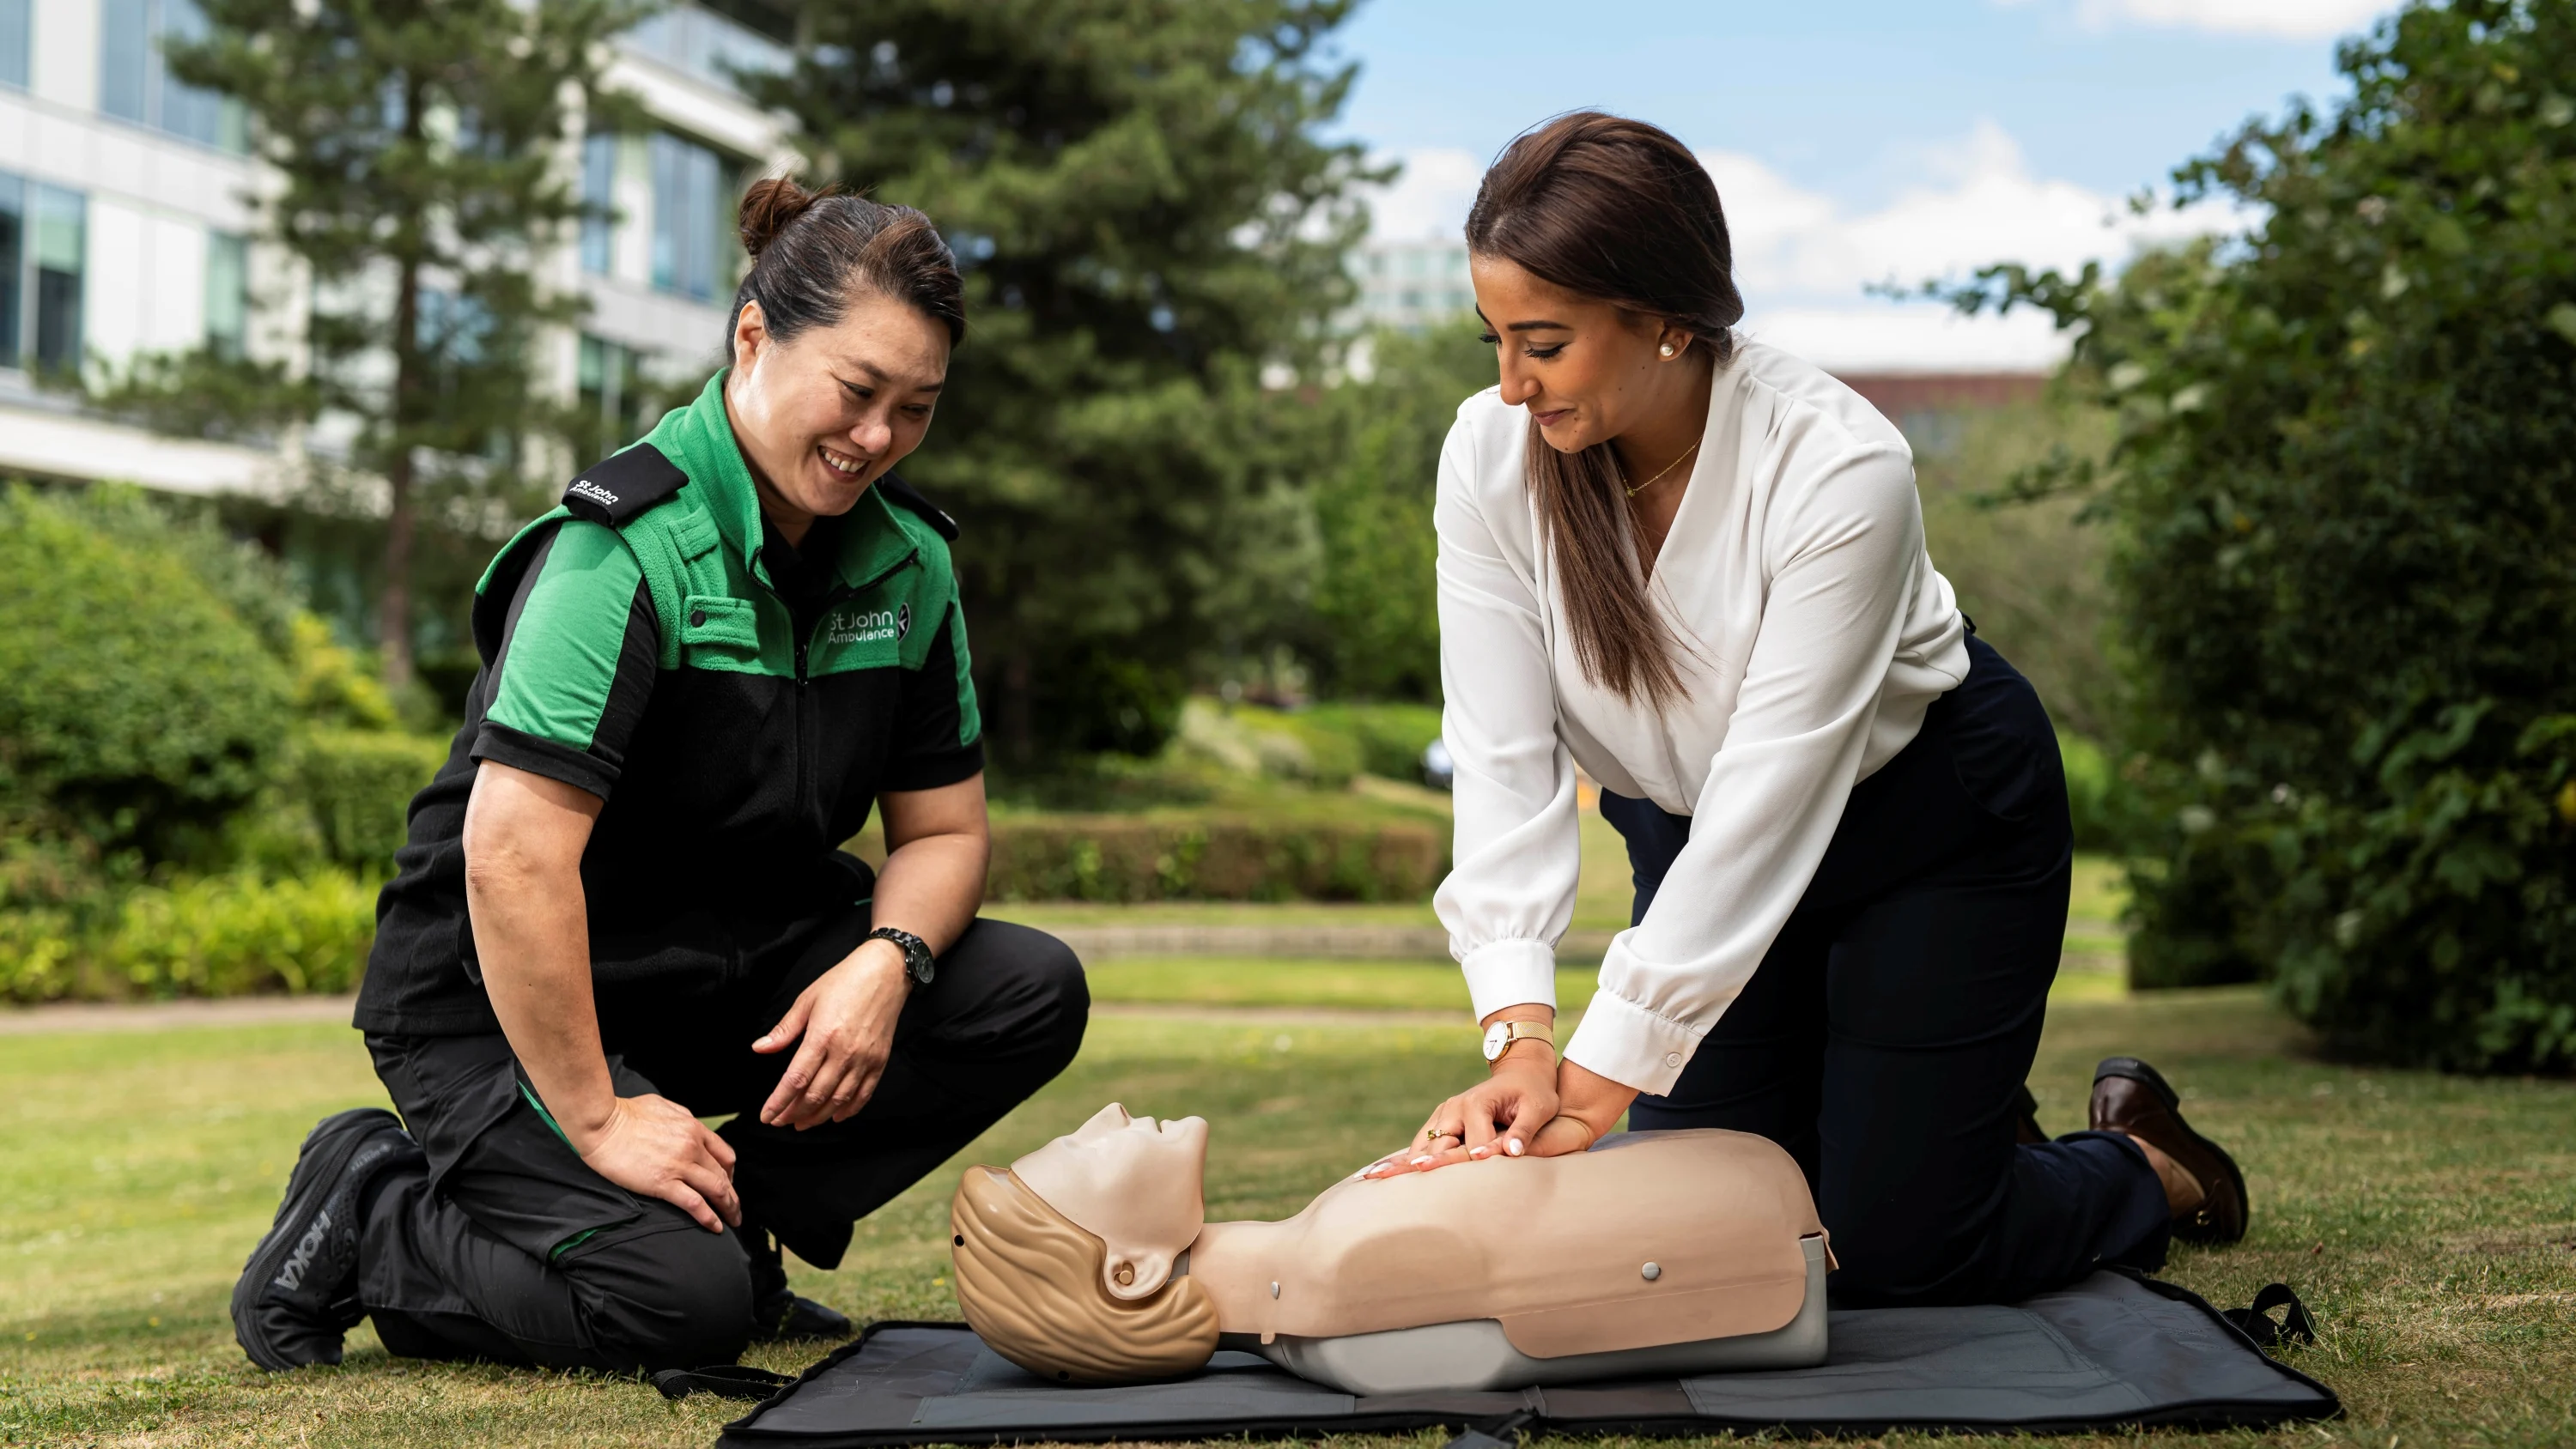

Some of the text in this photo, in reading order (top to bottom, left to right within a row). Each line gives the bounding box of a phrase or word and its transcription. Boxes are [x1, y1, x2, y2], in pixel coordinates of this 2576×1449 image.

[569, 486, 612, 505] Ambulance
[575, 480, 619, 503] St John
[848, 610, 893, 628] John
[828, 627, 895, 644] Ambulance
[274, 1210, 331, 1291] HOKA
